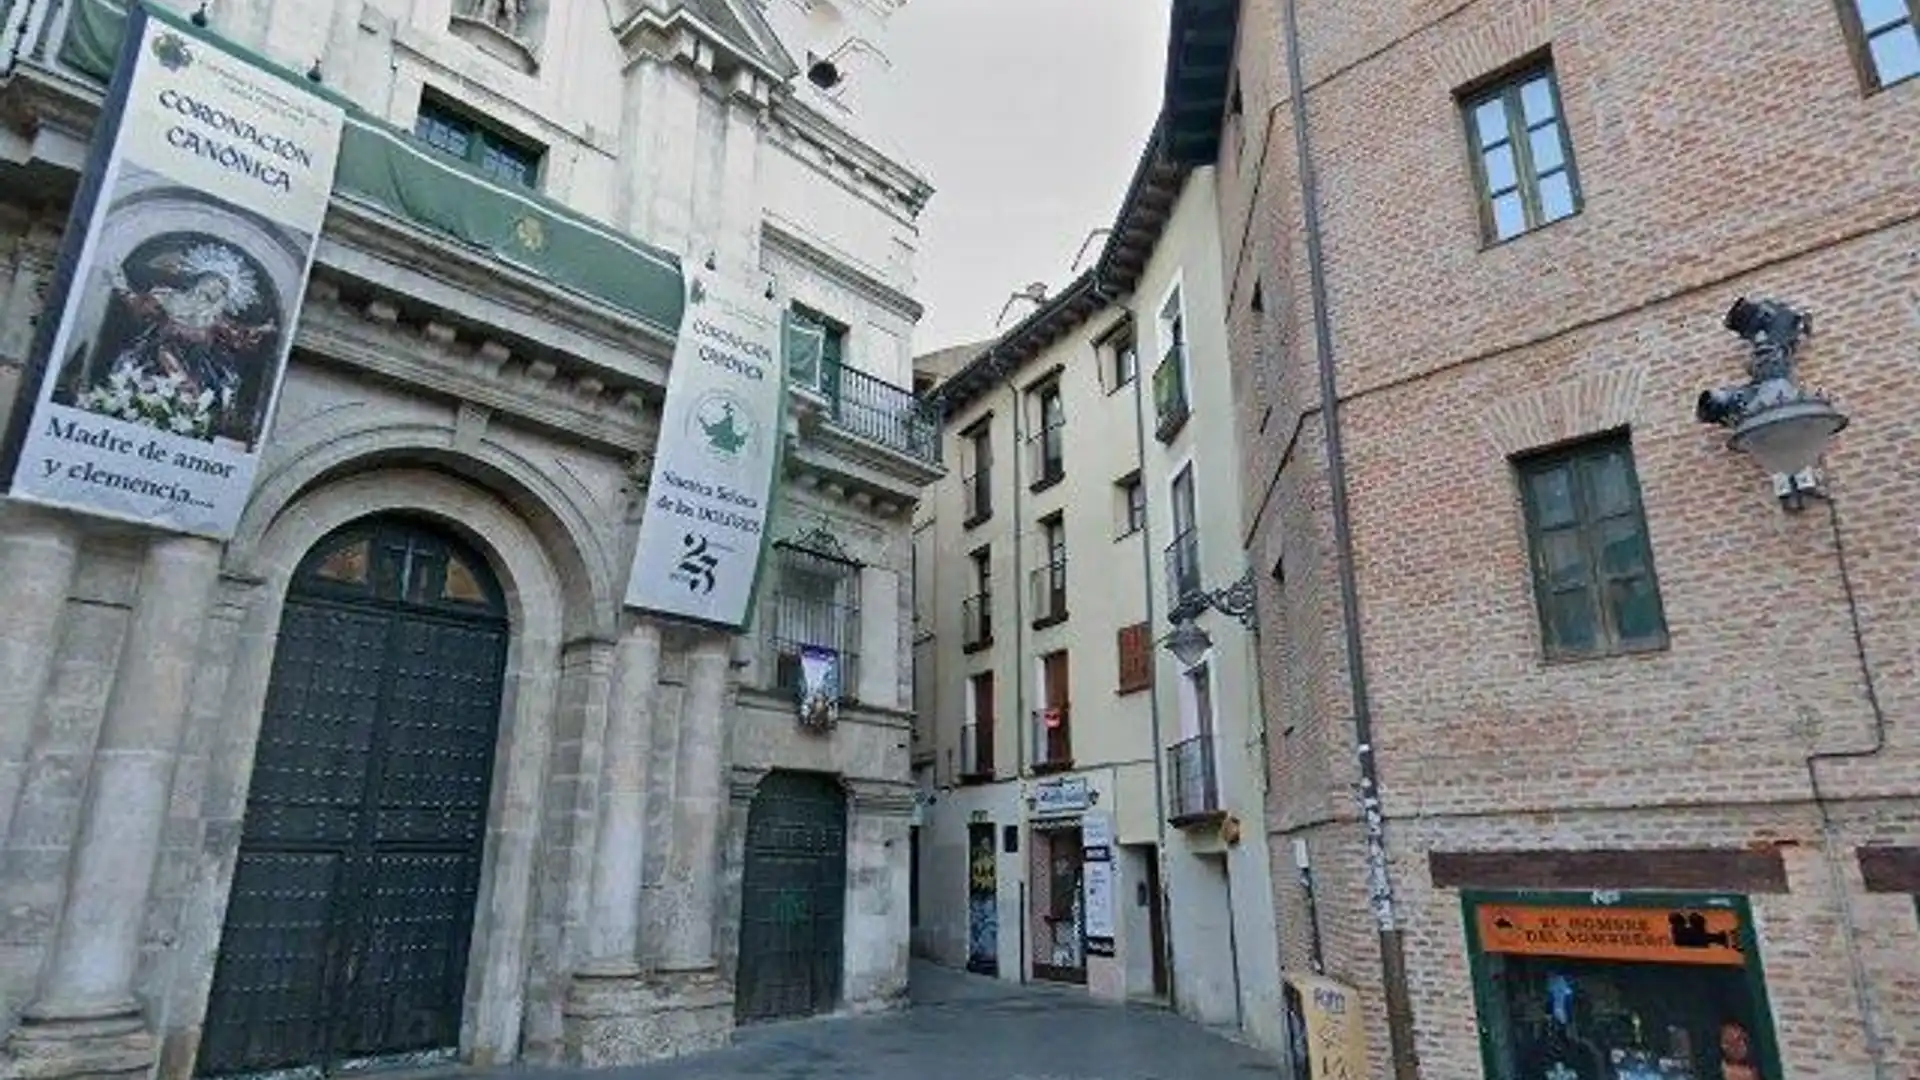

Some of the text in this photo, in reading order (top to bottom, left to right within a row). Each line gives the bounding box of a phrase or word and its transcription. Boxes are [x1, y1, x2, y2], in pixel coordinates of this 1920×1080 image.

[41, 457, 62, 478] y
[45, 416, 237, 480] Madre de amor
